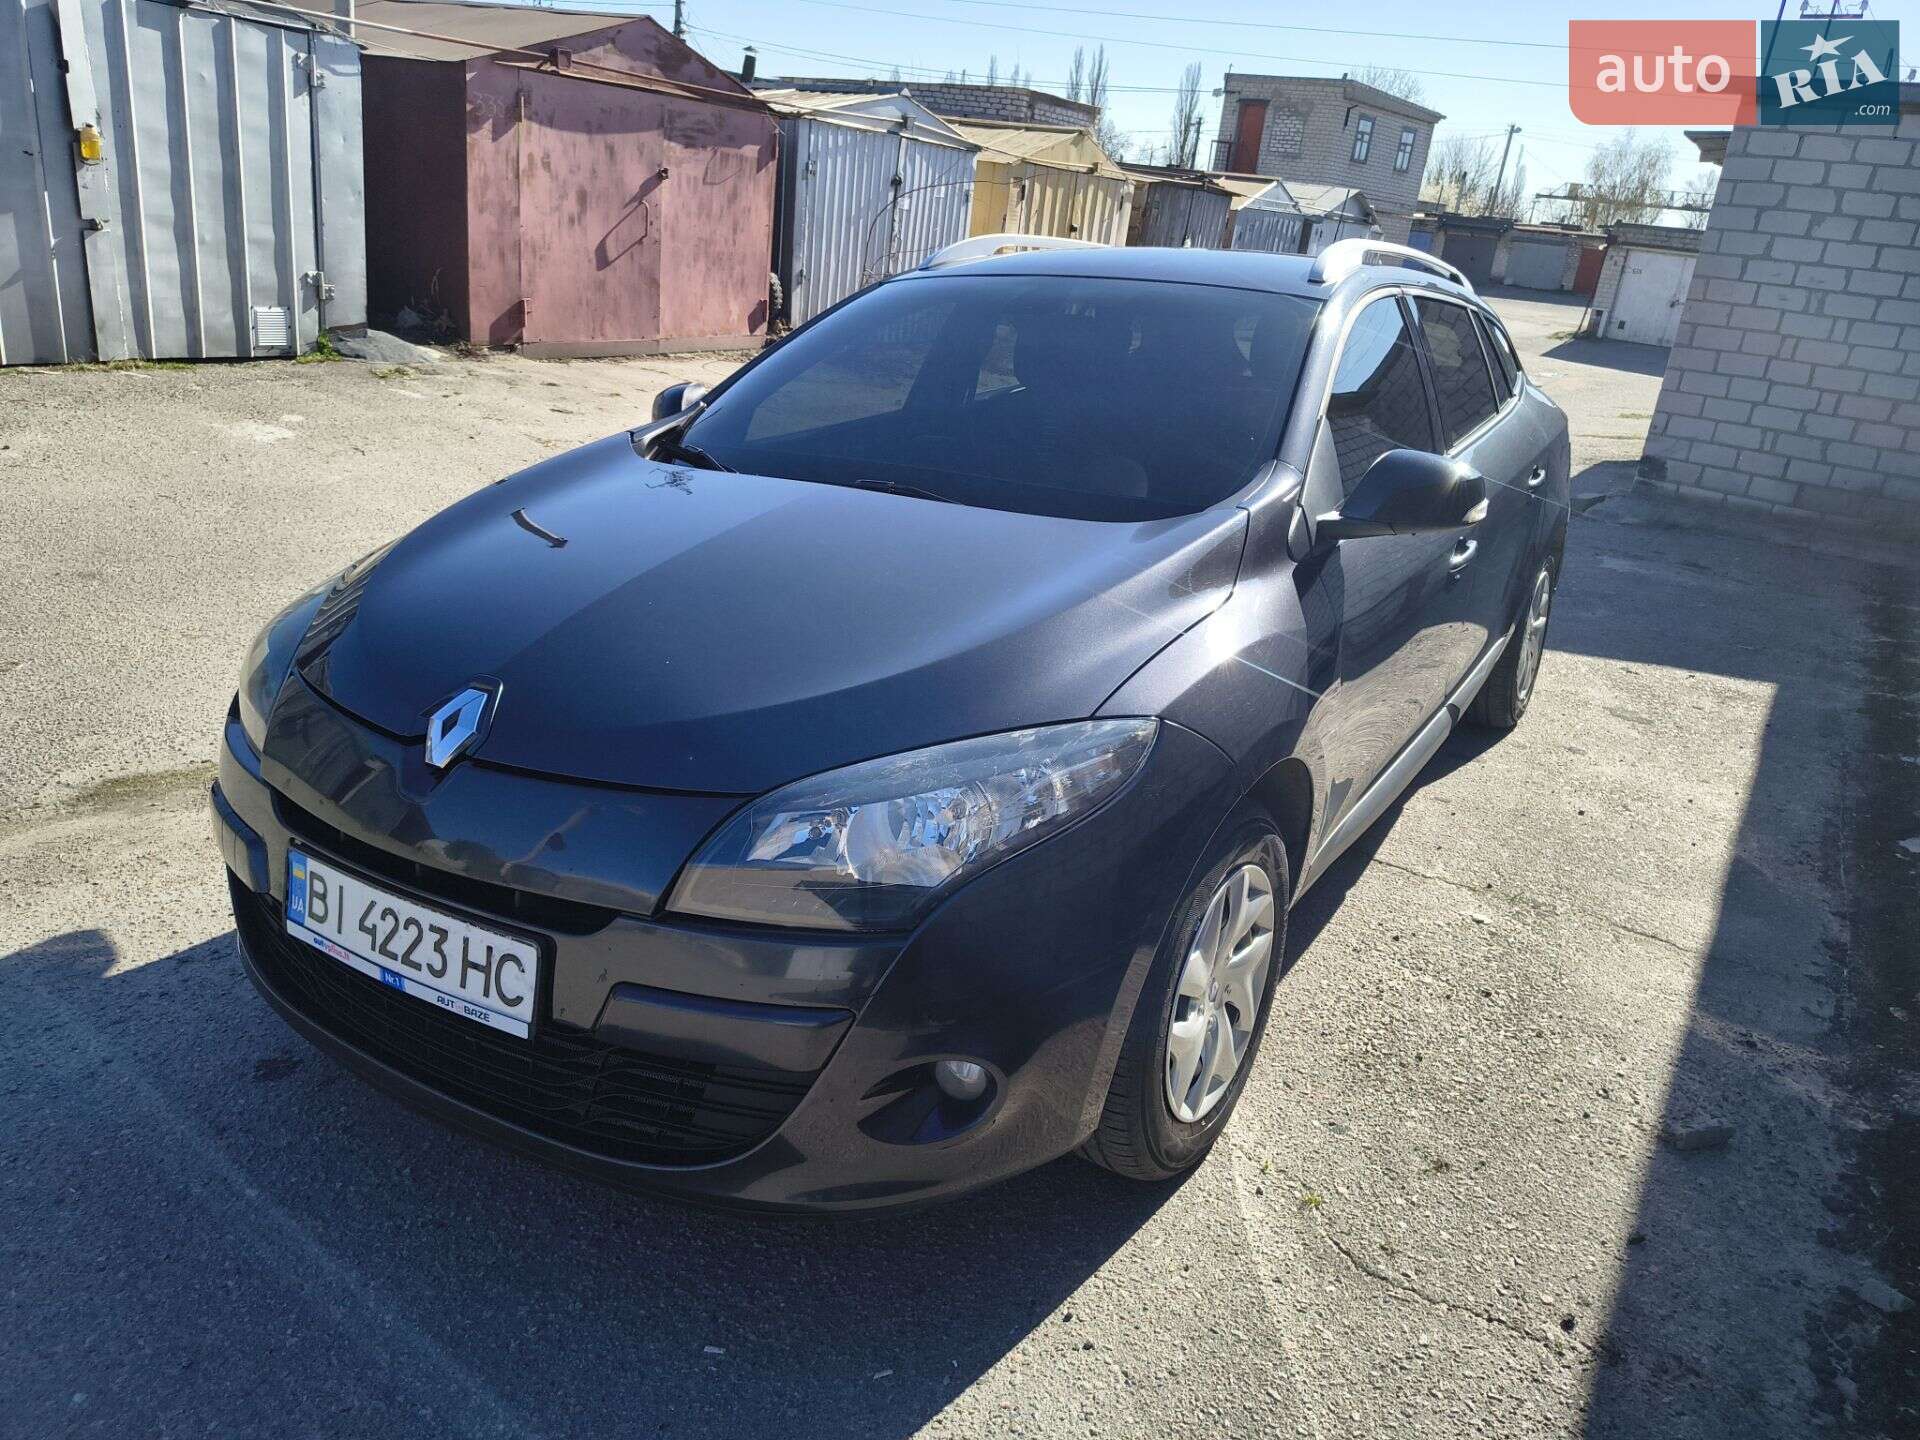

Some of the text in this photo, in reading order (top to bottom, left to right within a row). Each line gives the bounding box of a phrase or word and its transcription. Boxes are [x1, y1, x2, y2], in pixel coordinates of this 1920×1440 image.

[291, 895, 304, 913] UA
[308, 870, 526, 1008] BI 4223 HC
